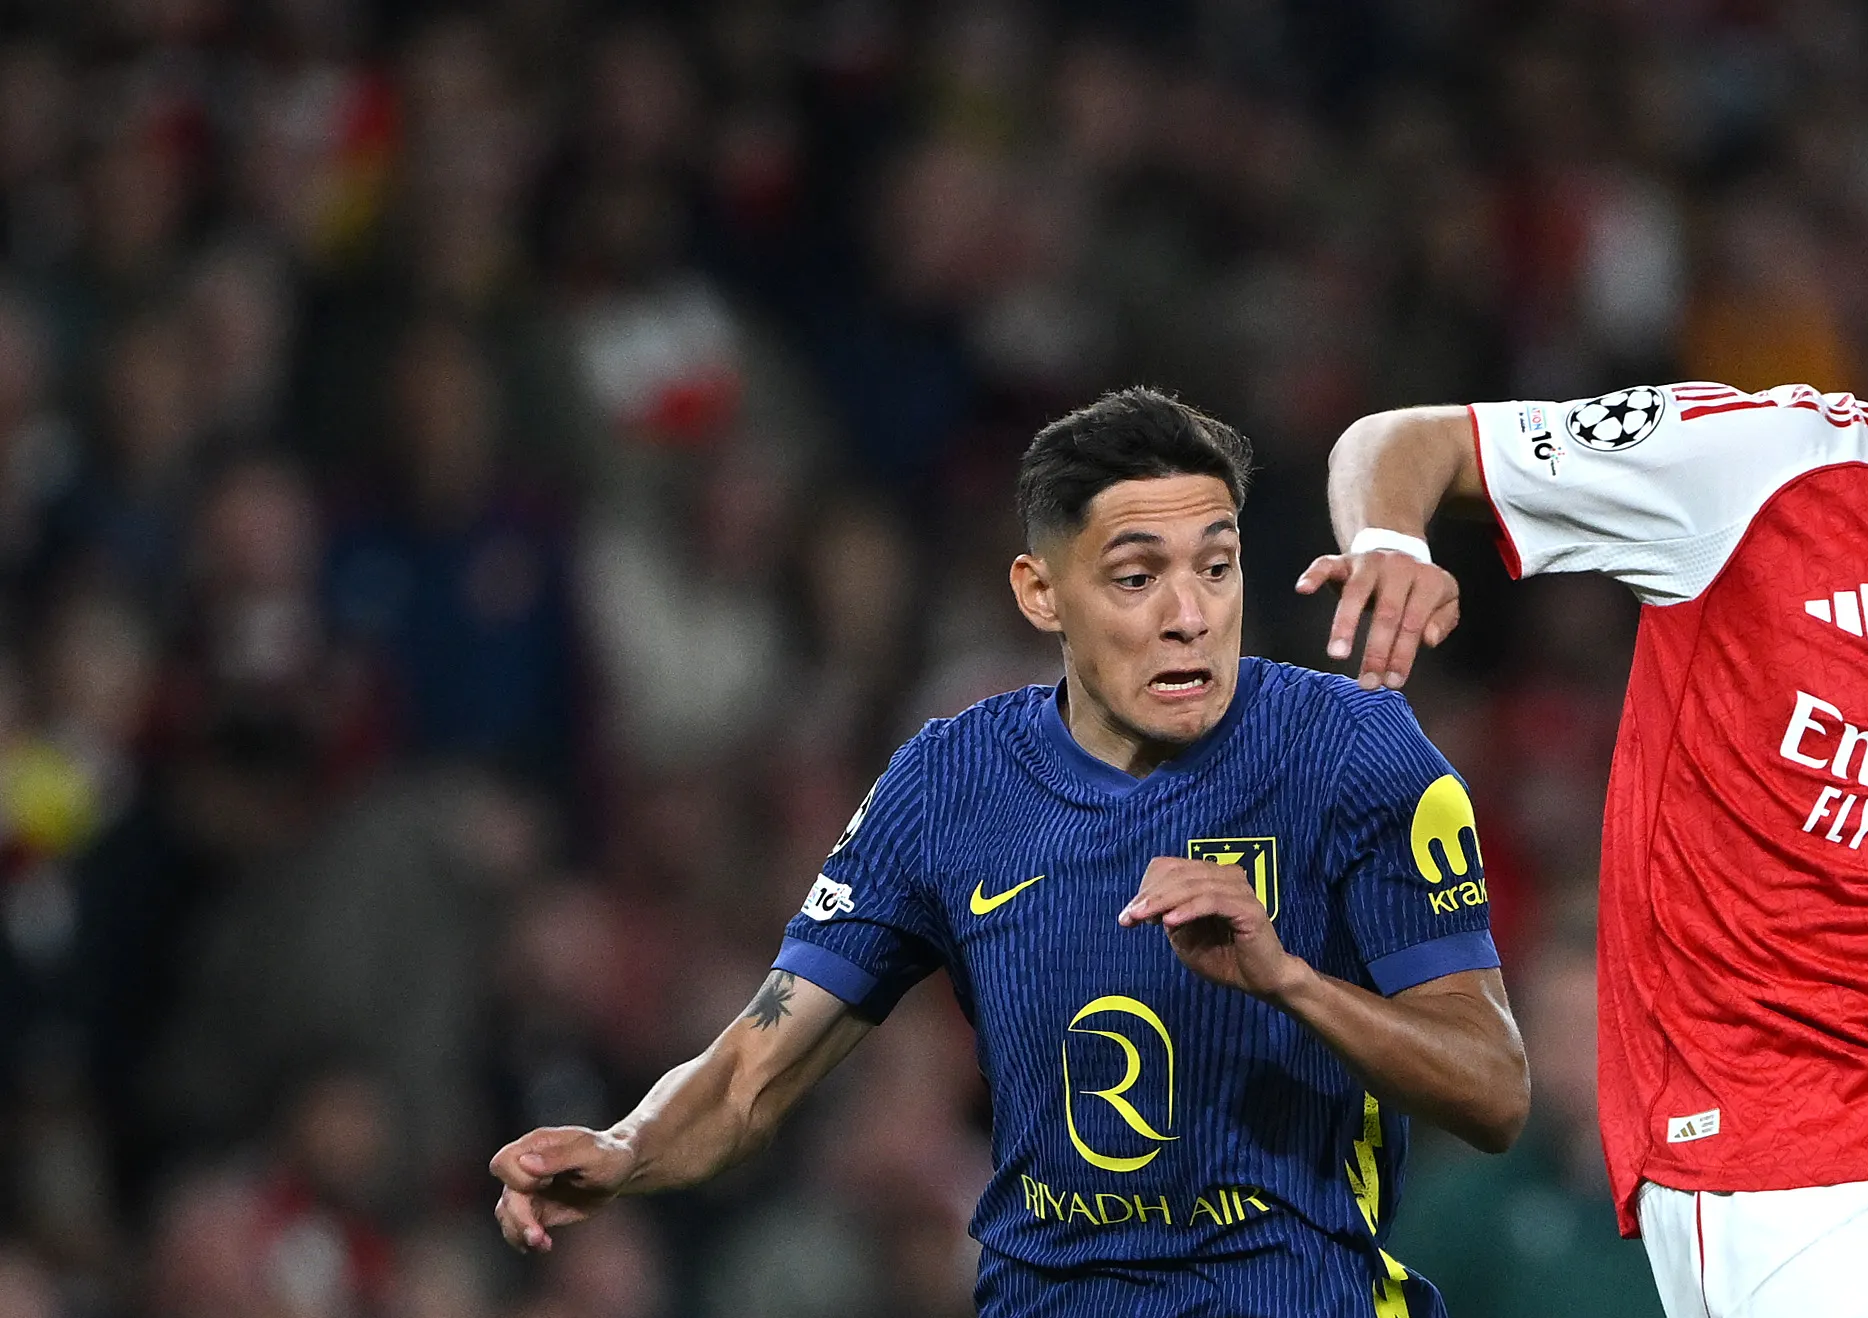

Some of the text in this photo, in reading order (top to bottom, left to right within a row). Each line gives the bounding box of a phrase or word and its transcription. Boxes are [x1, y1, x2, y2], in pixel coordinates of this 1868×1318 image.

[1531, 431, 1555, 460] 10
[1021, 1174, 1270, 1226] RIYADH AIR
